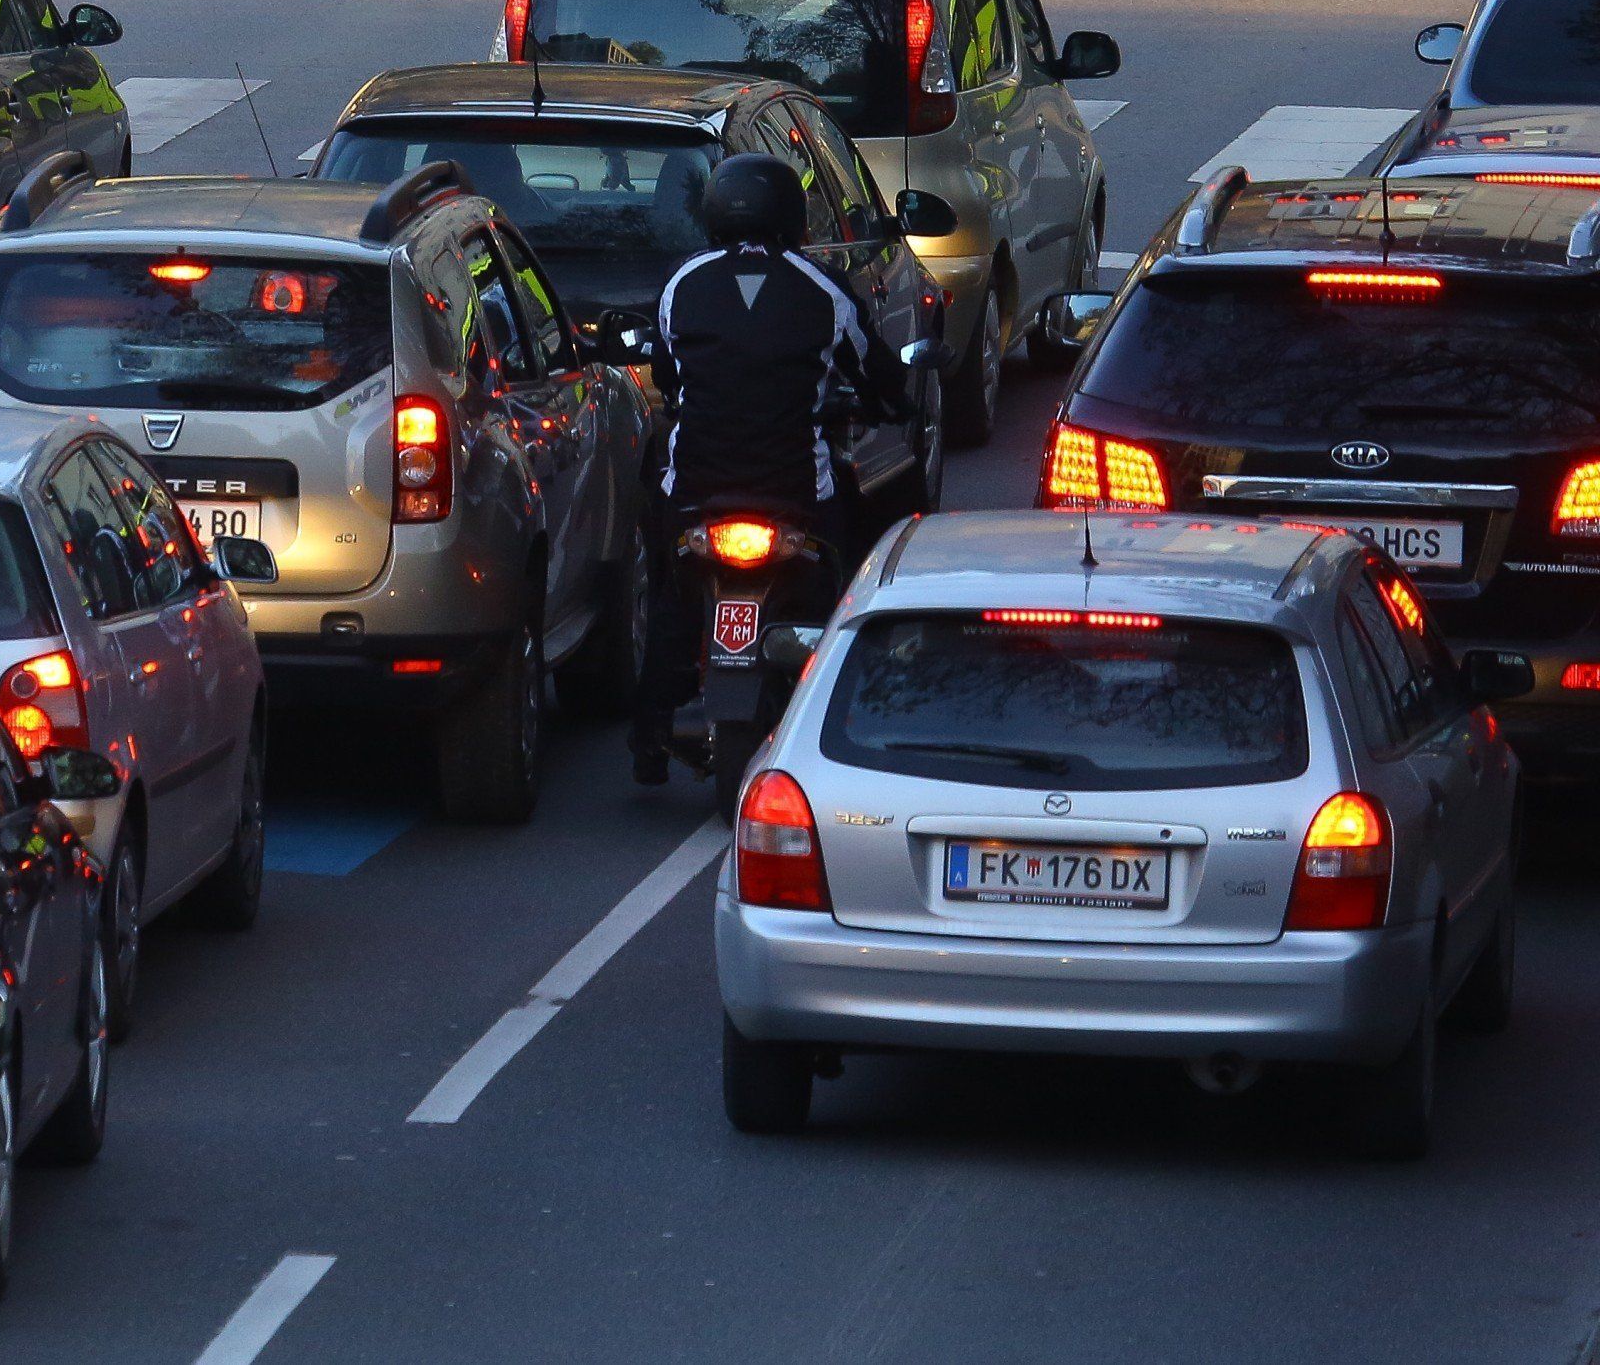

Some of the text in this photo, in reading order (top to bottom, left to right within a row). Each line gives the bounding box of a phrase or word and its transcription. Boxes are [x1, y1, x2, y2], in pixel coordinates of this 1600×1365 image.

[1341, 447, 1379, 464] KIA
[165, 479, 247, 494] TER
[1383, 527, 1441, 558] HCS
[1520, 563, 1546, 572] AUTO
[1547, 565, 1578, 573] MAIER
[721, 625, 751, 641] 7 RM
[1227, 827, 1287, 841] mazda
[980, 852, 1020, 885] FK
[1047, 855, 1102, 889] 176
[1112, 860, 1151, 892] DX
